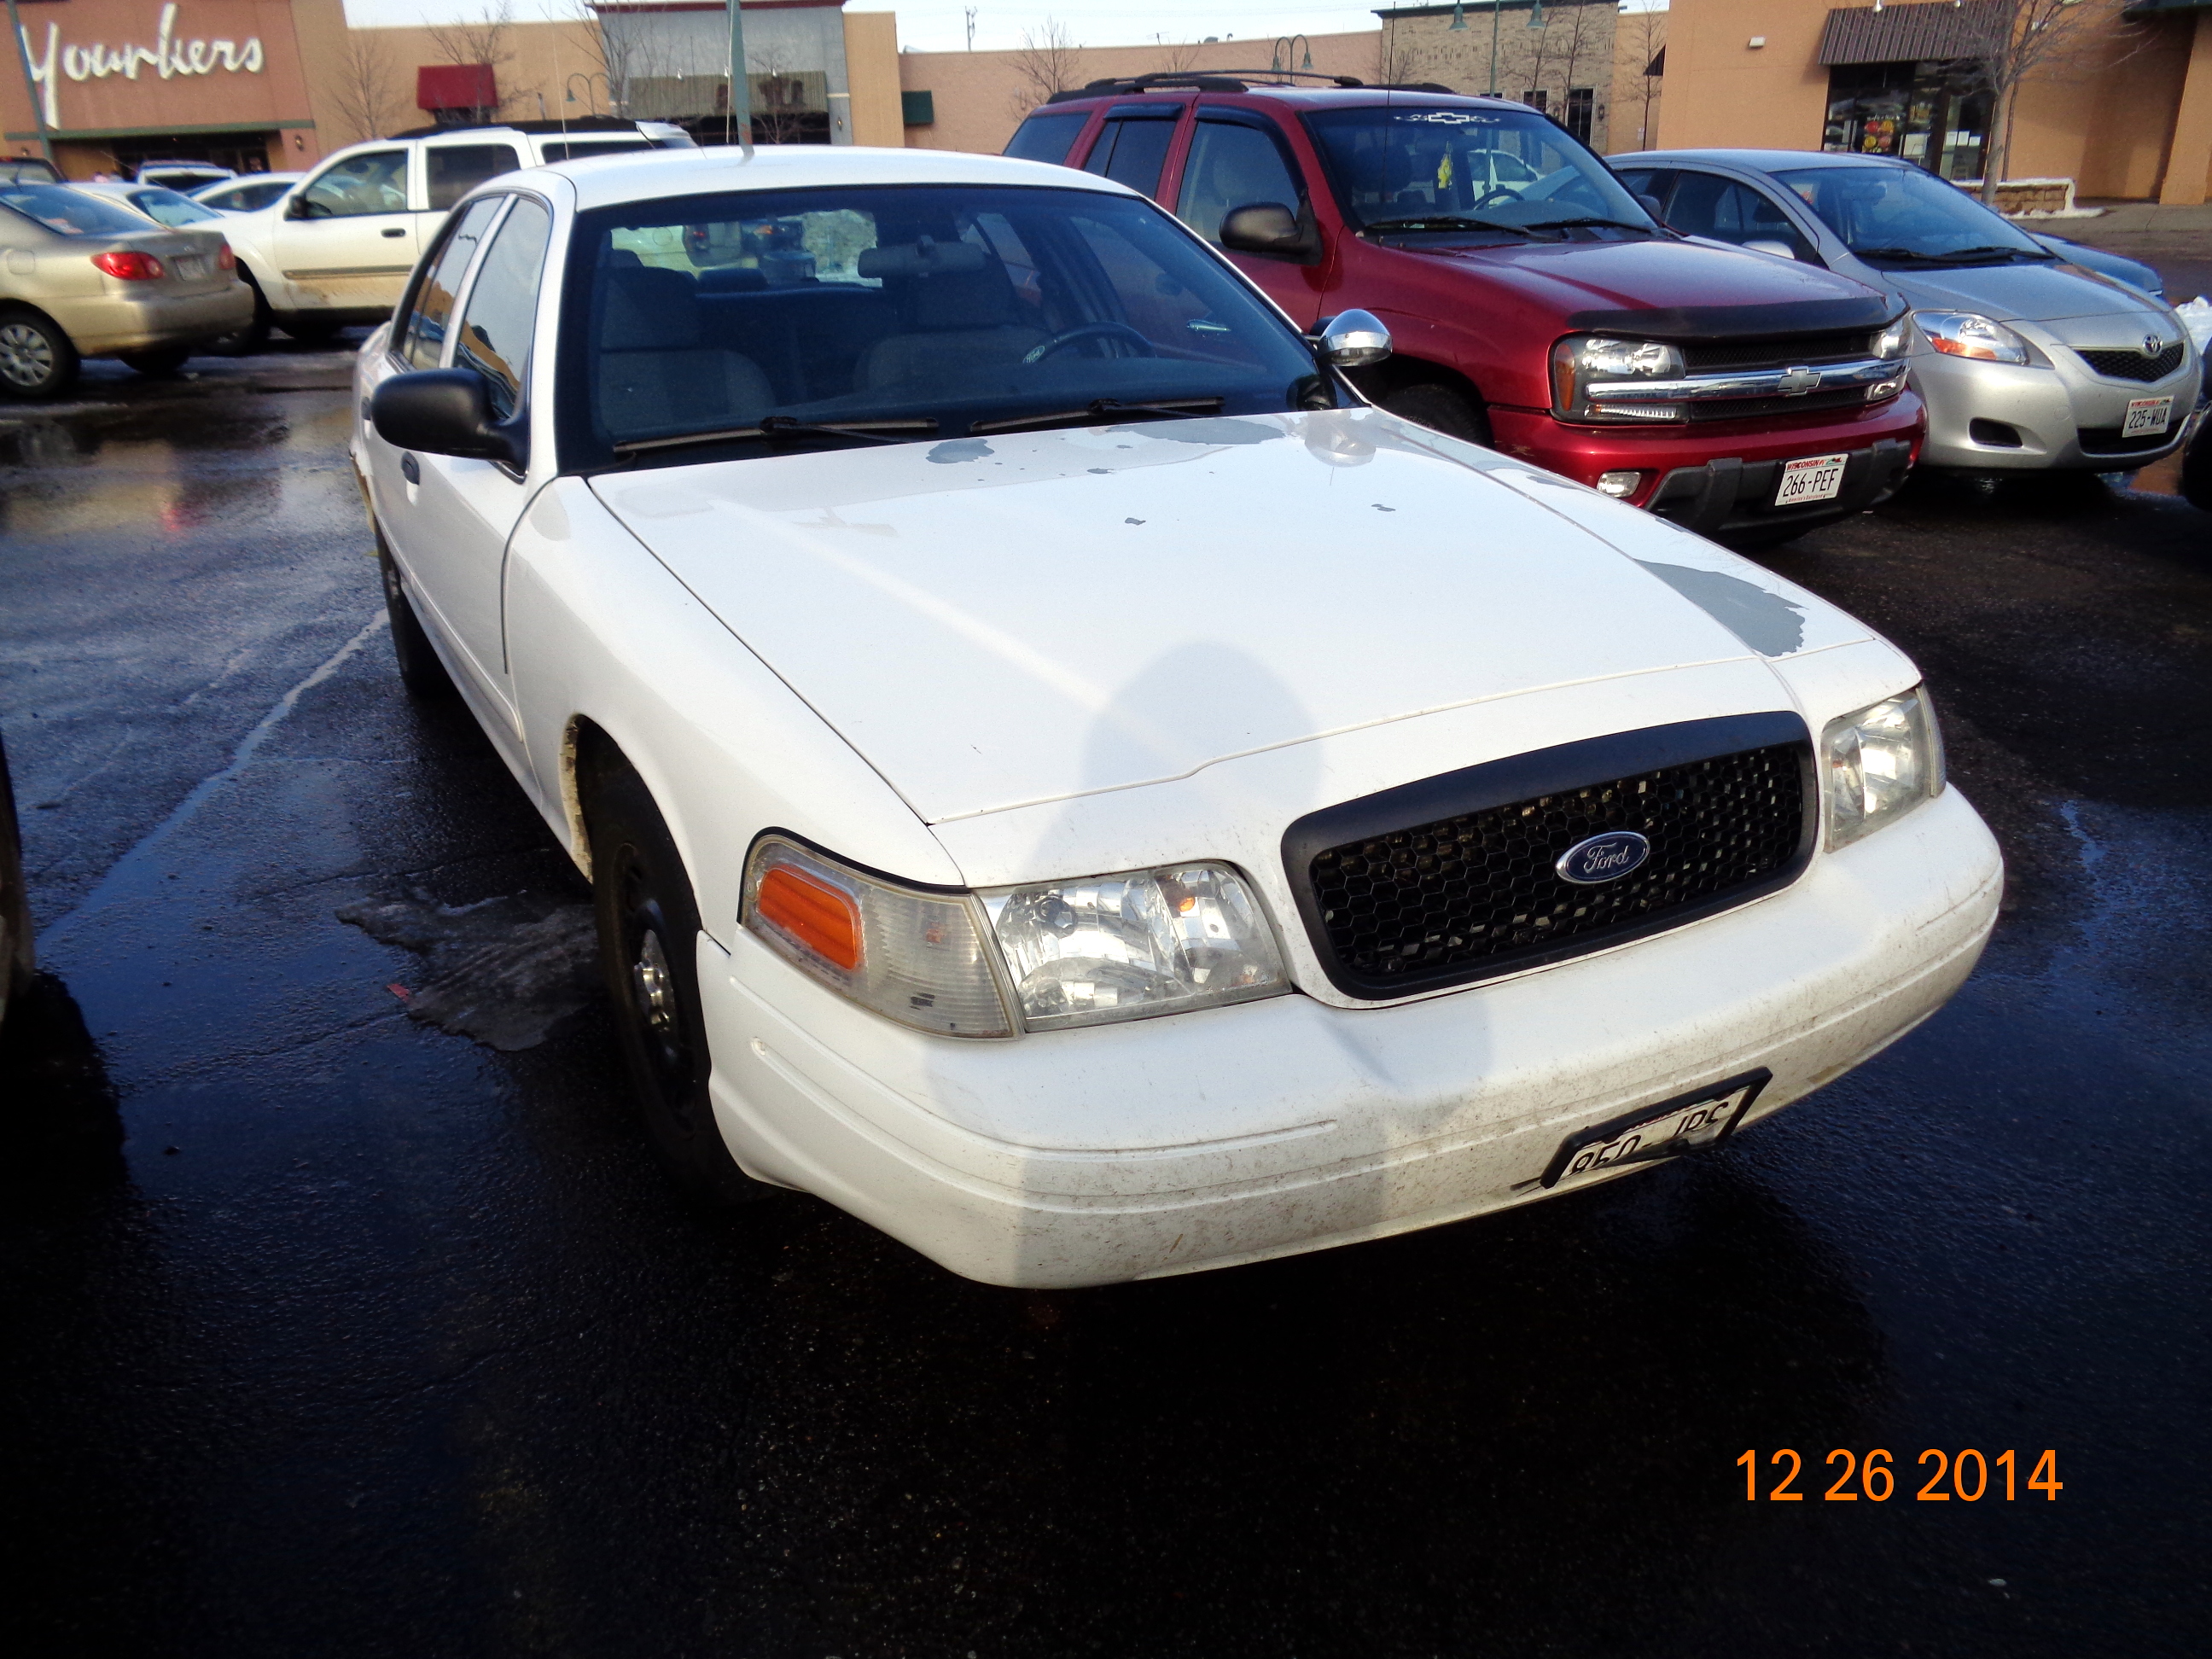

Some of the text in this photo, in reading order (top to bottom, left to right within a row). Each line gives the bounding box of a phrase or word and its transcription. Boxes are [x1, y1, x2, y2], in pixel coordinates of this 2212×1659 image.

[19, 2, 264, 131] Younkers
[1786, 460, 1819, 470] WISCONSIN
[1783, 468, 1838, 497] 266-PEF
[1583, 841, 1630, 874] Ford
